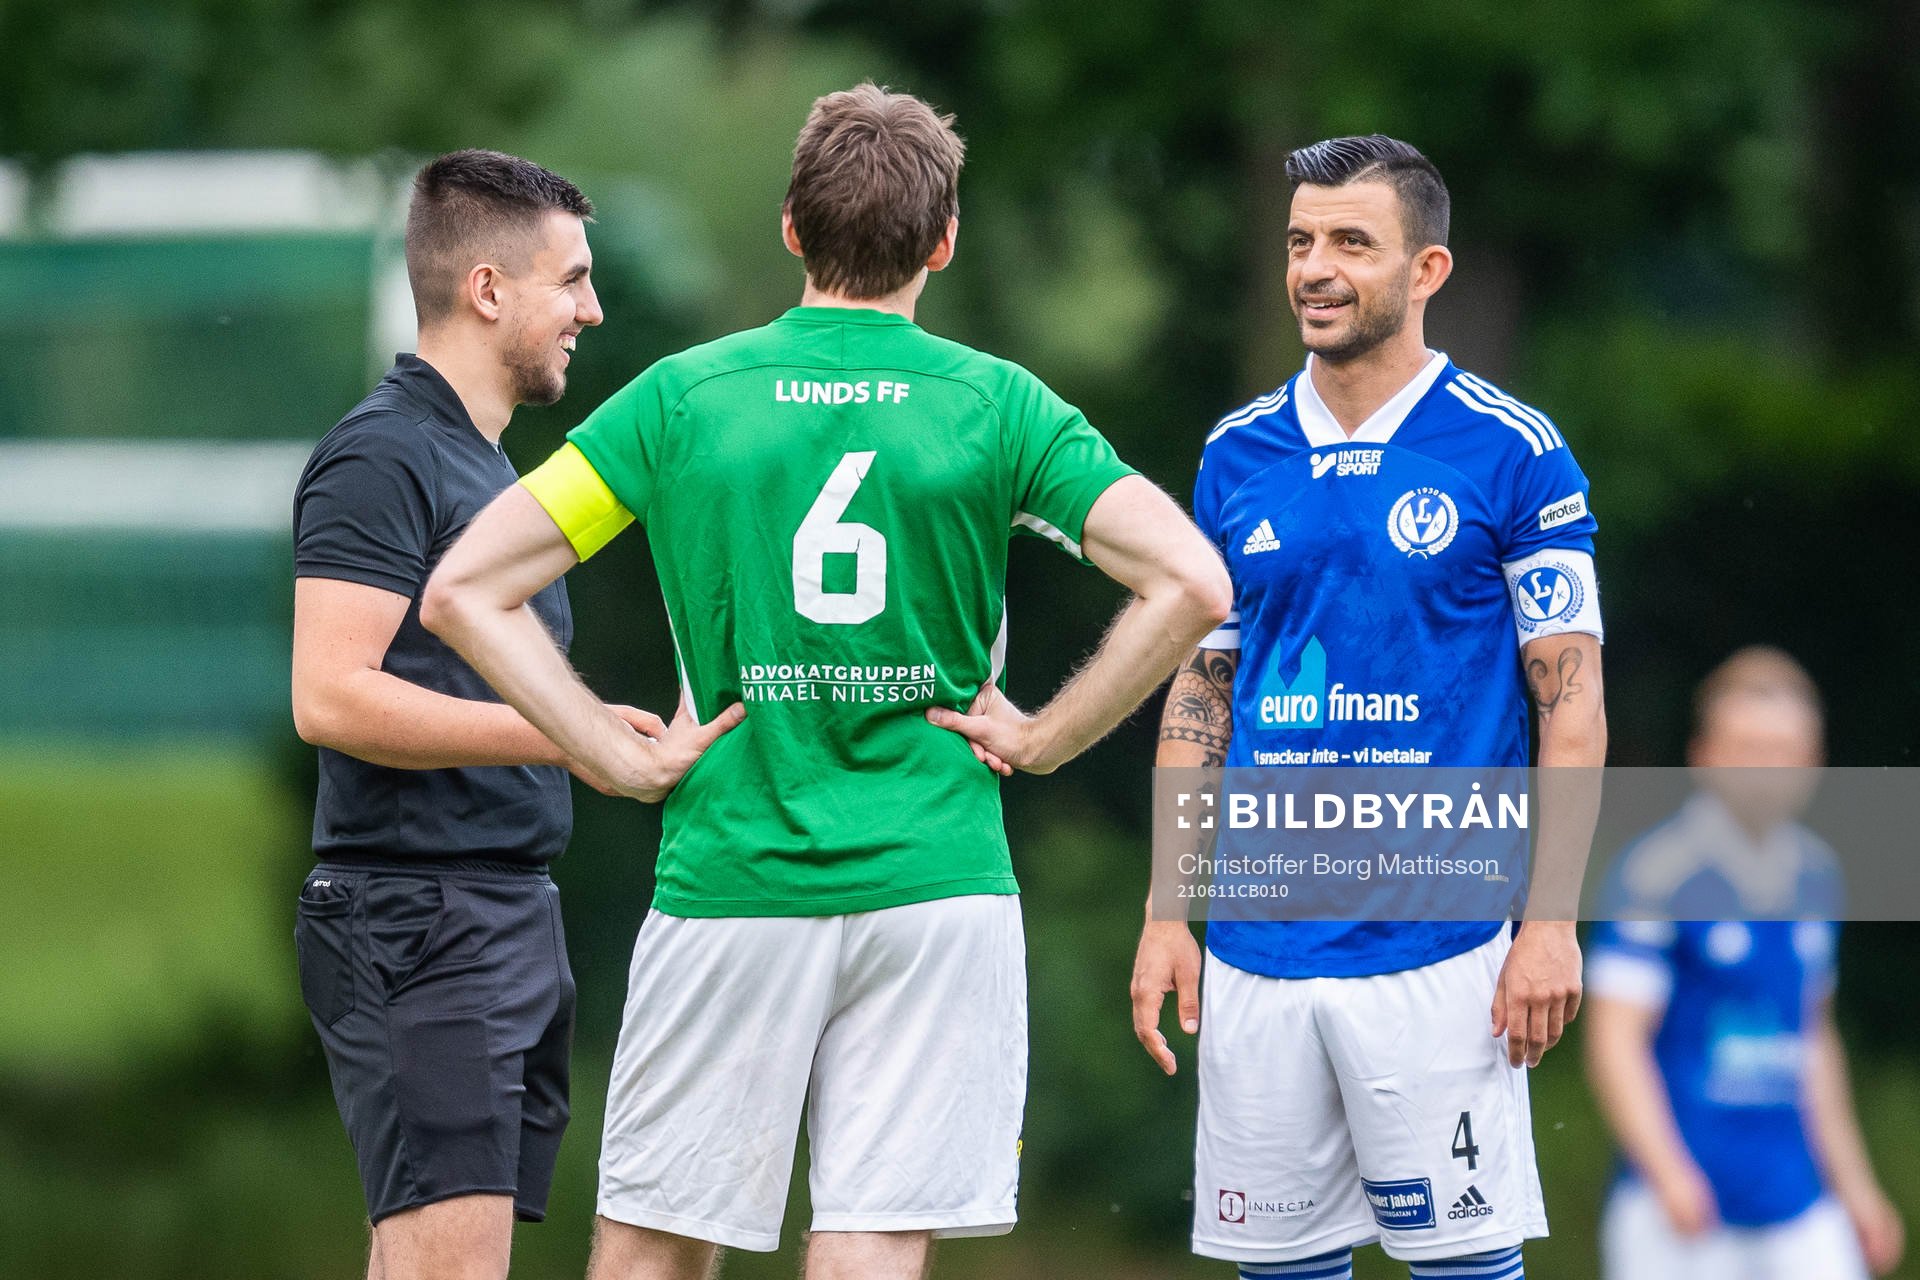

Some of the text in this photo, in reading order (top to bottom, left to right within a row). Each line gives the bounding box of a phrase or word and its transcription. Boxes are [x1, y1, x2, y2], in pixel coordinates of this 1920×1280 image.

[775, 379, 911, 404] LUNDS FF
[1338, 449, 1384, 463] INTER
[1336, 462, 1381, 476] SPORT
[1416, 487, 1440, 496] 1930
[1541, 501, 1581, 524] virotea
[792, 450, 887, 625] 6
[1243, 539, 1281, 555] adidas
[741, 663, 936, 681] ADVOKATGRUPPEN
[741, 683, 935, 704] MIKAEL NILSSON
[1260, 682, 1420, 723] euro finans
[1260, 749, 1311, 765] snackar
[1311, 748, 1339, 764] inte
[1352, 747, 1369, 763] vi
[1371, 747, 1433, 764] betalar
[1451, 1111, 1480, 1171] 4
[1248, 1199, 1315, 1213] INNECTA
[1389, 1192, 1426, 1209] Jakobs
[1447, 1205, 1494, 1220] adidas
